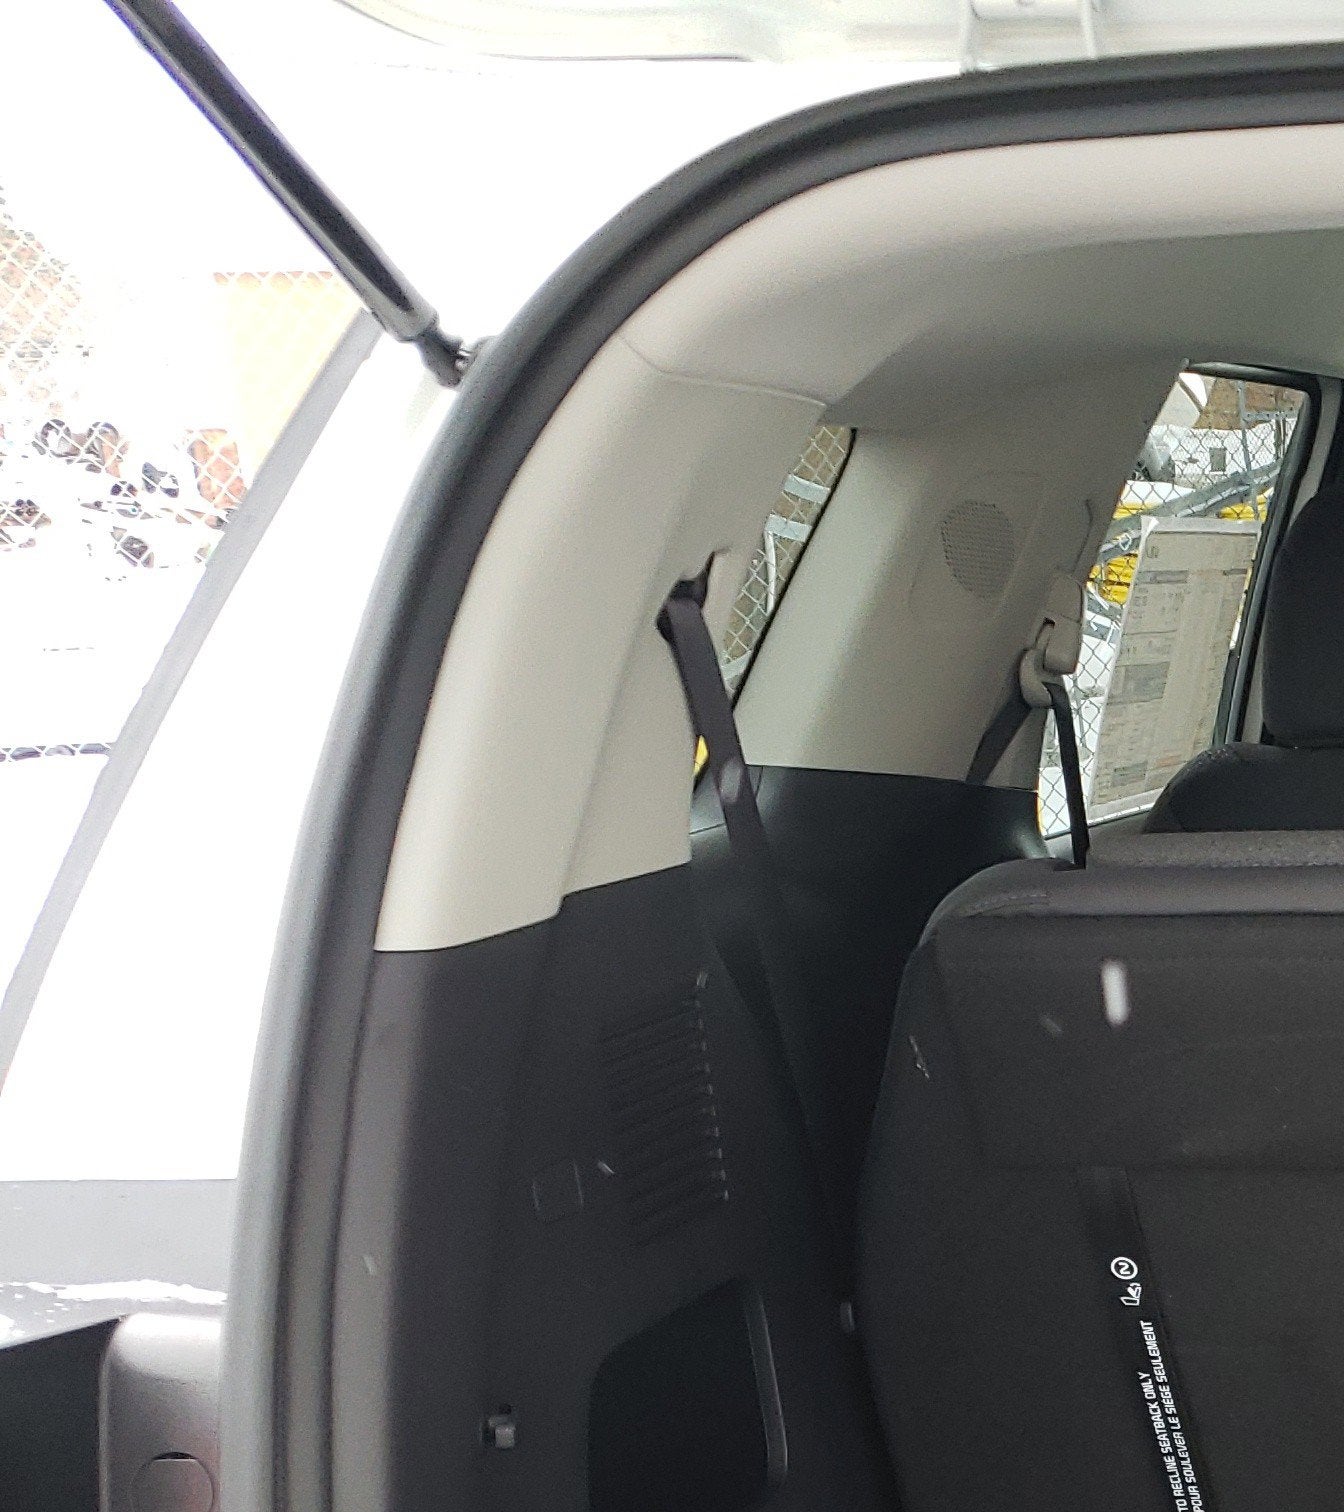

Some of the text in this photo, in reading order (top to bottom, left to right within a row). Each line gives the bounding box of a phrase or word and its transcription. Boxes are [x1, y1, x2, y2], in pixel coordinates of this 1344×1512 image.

[1140, 1320, 1168, 1383] SEULEMENT
[1137, 1371, 1188, 1512] TO RECLINE SEATBACK ONLY
[1167, 1416, 1181, 1430] LE
[1172, 1431, 1197, 1483] SOULEVER
[1187, 1485, 1205, 1512] POUR
